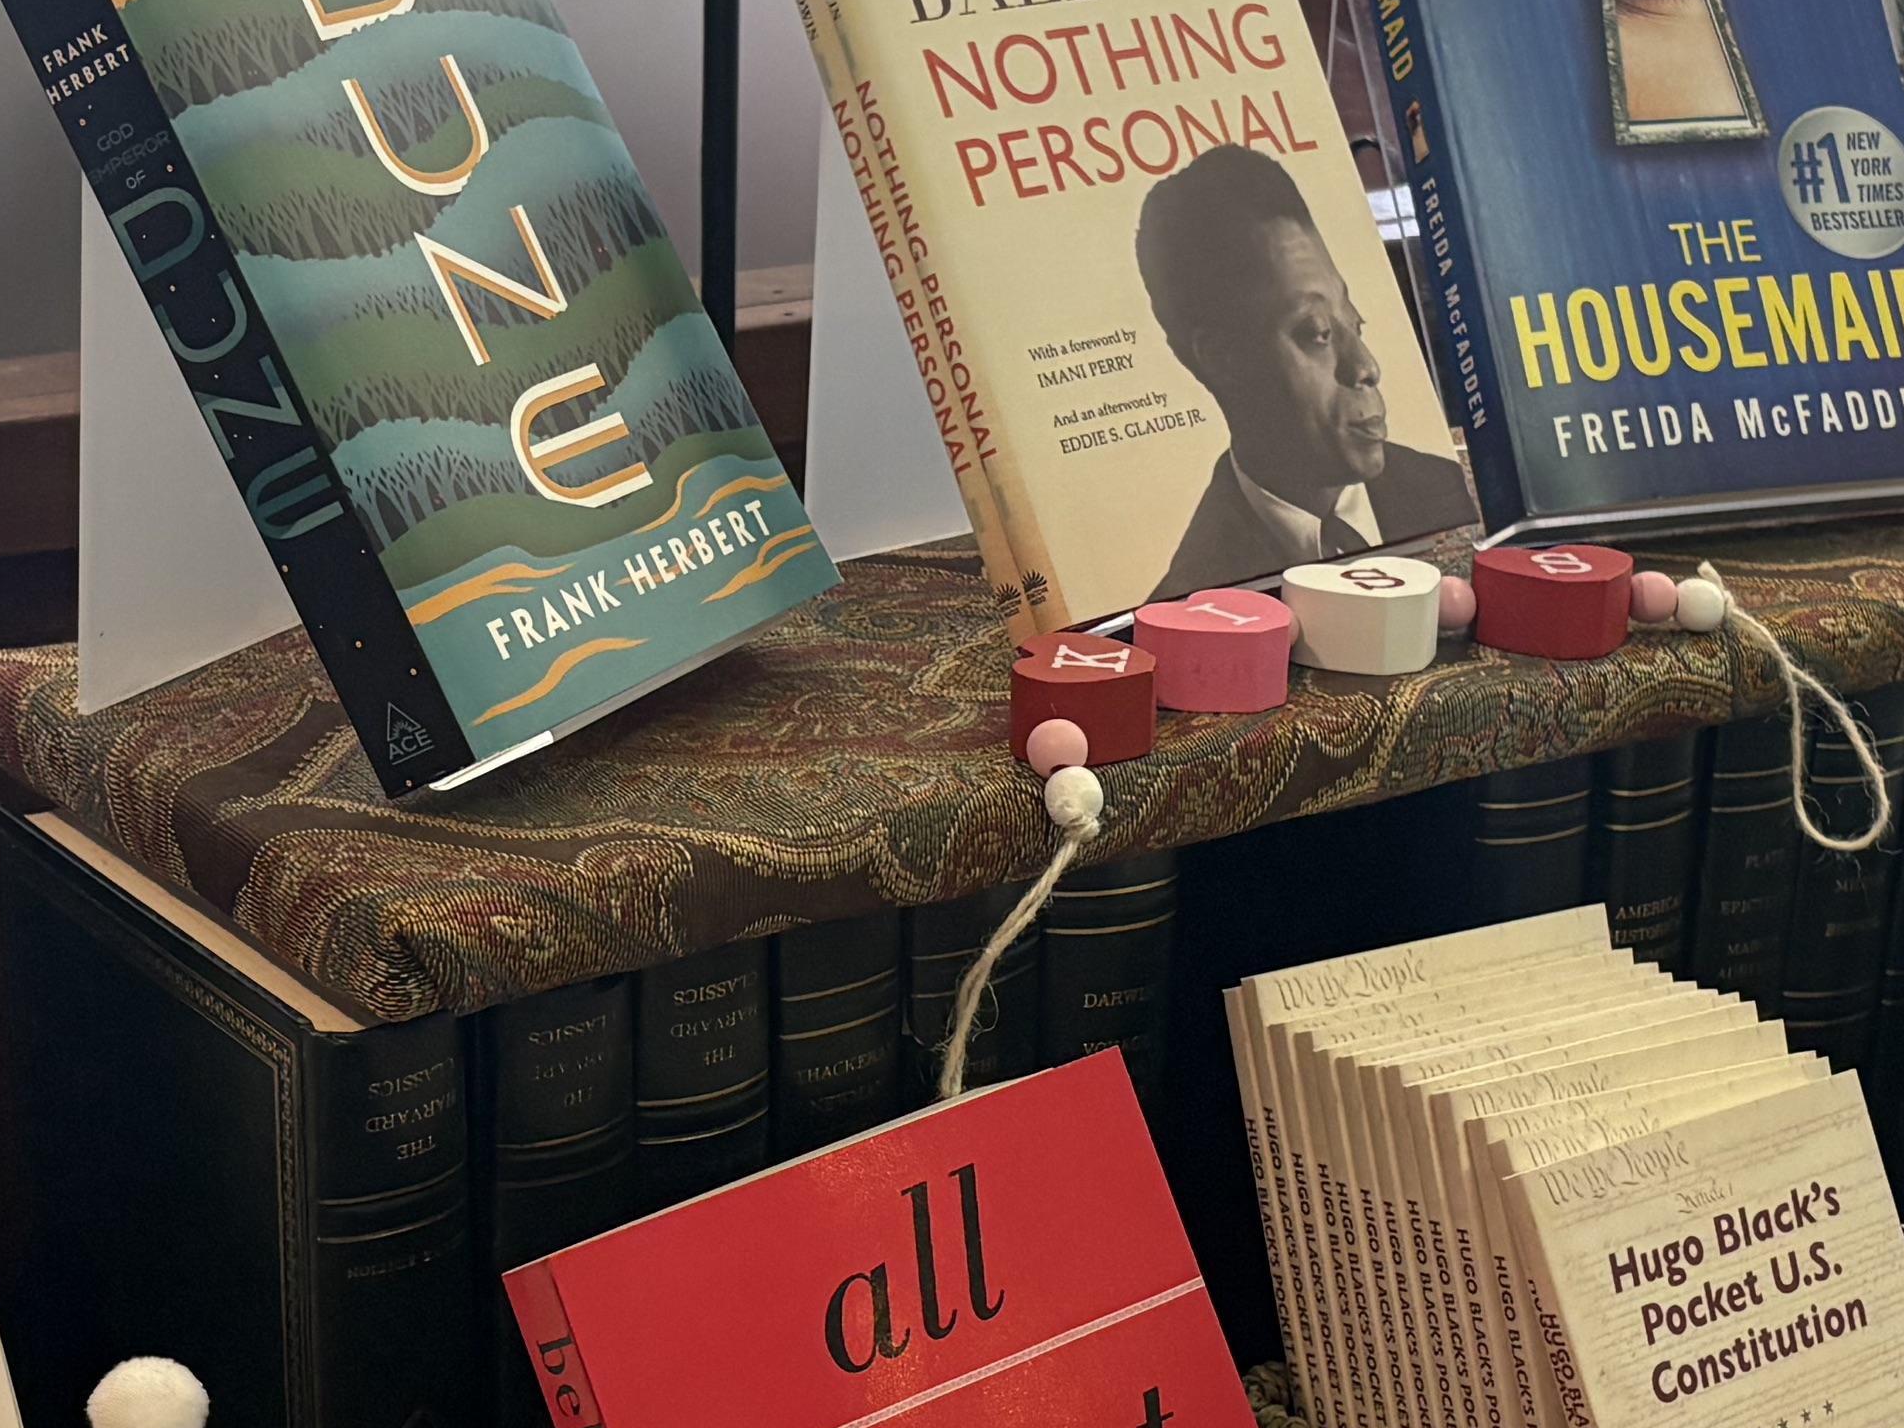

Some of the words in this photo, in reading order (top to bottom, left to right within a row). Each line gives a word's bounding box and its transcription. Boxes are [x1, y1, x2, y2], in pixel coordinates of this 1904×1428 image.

[922, 2, 1288, 119] NOTHING
[953, 89, 1318, 209] PERSONAL
[1790, 131, 1854, 206] #1
[1846, 129, 1882, 154] NEW
[1850, 154, 1894, 179] YORK
[1669, 218, 1763, 268] THE
[1037, 363, 1088, 388] IMANI
[1090, 353, 1135, 378] PERRY
[1059, 429, 1109, 455] EDDIE
[1111, 426, 1124, 443] S.
[1124, 411, 1187, 440] GLAUDE
[1188, 408, 1207, 428] JR.
[1553, 401, 1715, 460] FREIDA
[484, 572, 621, 662] FRANK
[622, 497, 779, 598] HERBERT
[822, 1162, 1008, 1377] all
[1606, 1225, 1705, 1297] Hugo
[1712, 1179, 1844, 1255] Black's
[1639, 1266, 1764, 1348] Pocket
[1769, 1239, 1845, 1294] U.S.
[1650, 1289, 1870, 1406] Constitution
